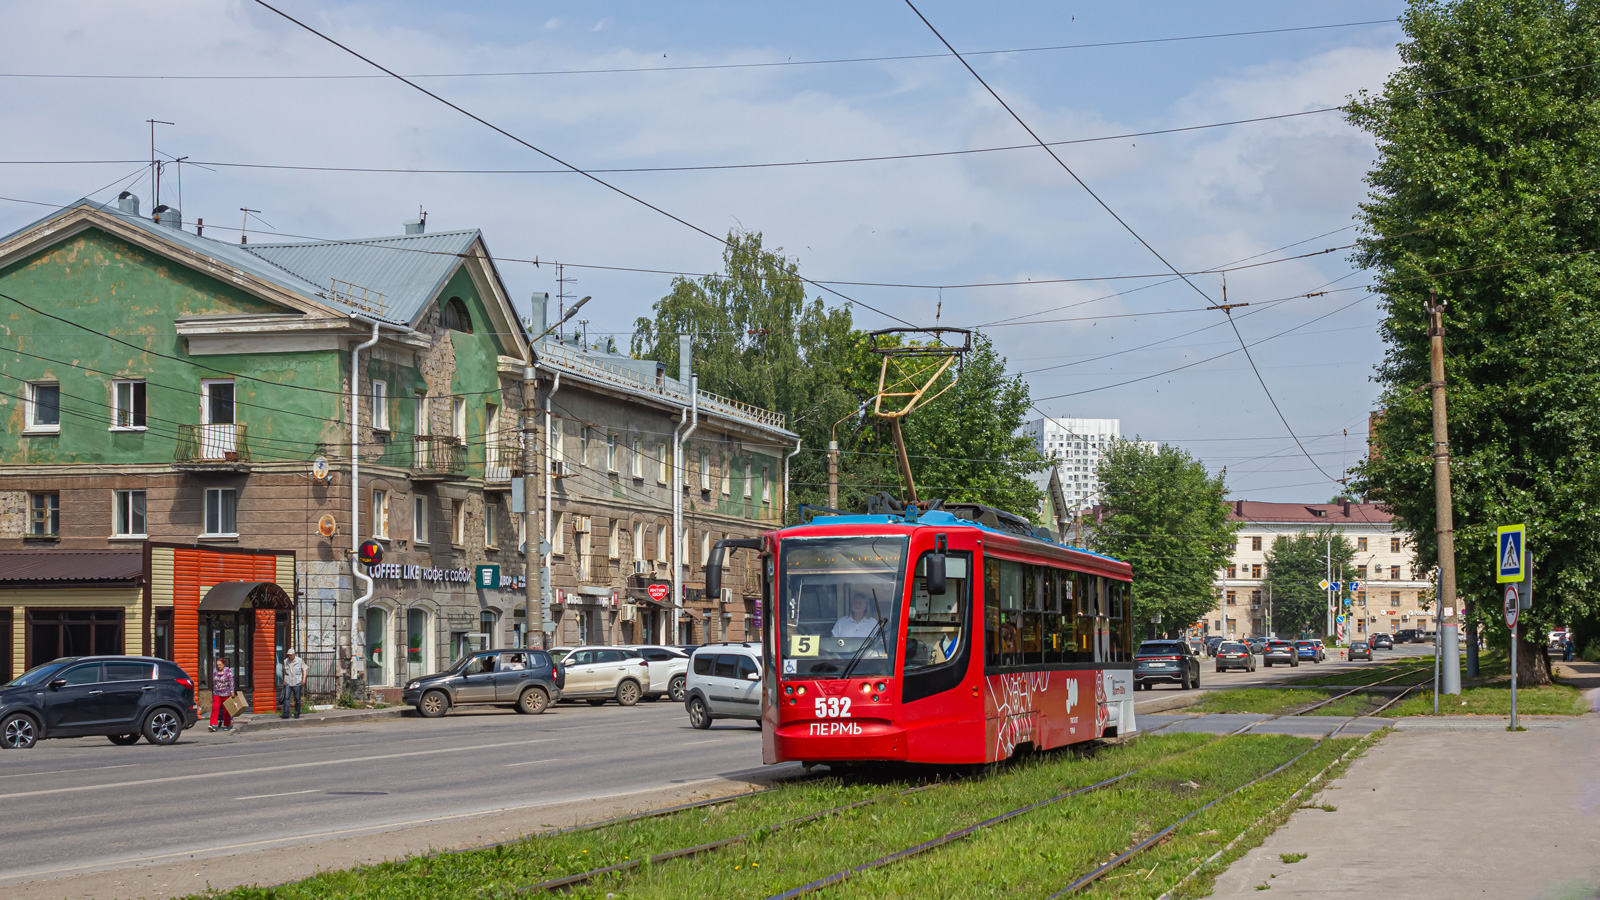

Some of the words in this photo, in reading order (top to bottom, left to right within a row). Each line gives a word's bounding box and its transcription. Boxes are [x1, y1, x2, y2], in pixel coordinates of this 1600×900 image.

[369, 563, 400, 579] COFFEE
[403, 565, 420, 580] LIKE
[423, 565, 443, 583] кофе
[450, 567, 471, 582] собой
[797, 637, 811, 653] 5
[814, 696, 852, 718] 532
[809, 722, 863, 736] ПЕРМЬ
